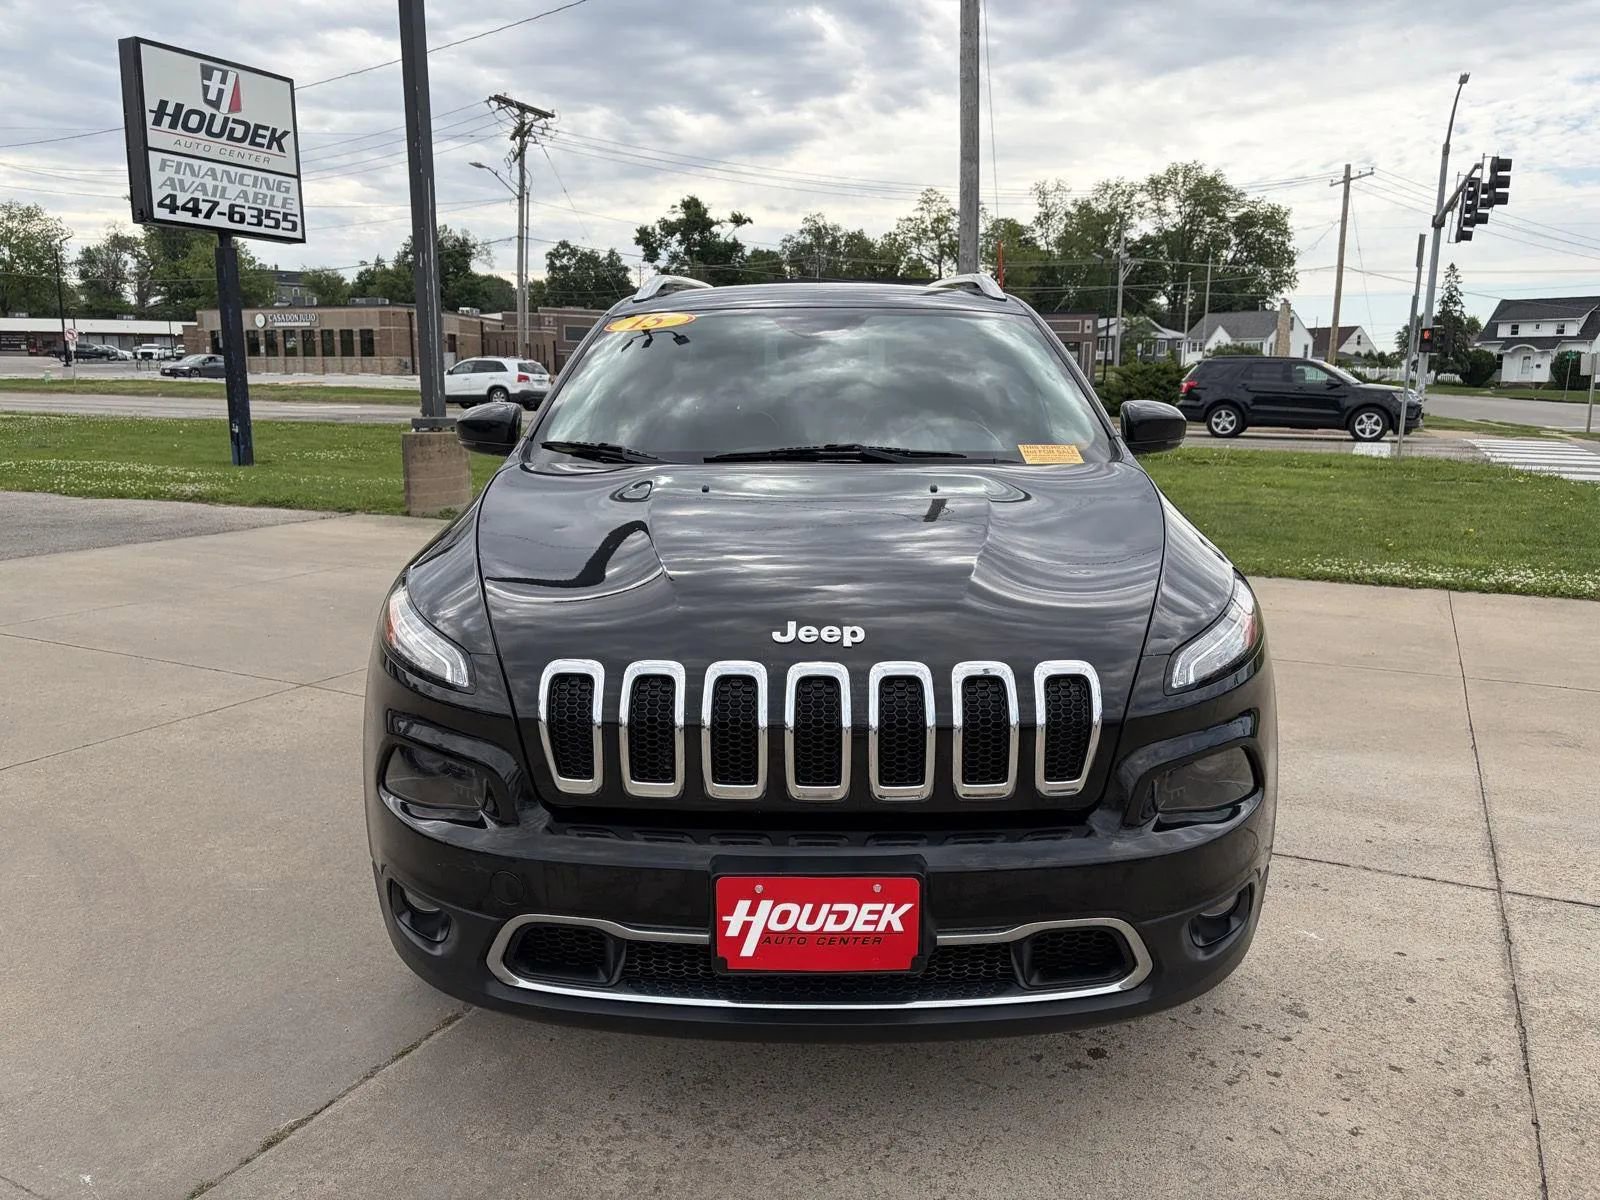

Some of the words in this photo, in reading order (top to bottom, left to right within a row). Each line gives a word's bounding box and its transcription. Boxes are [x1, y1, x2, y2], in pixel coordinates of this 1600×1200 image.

[149, 98, 291, 153] HOUDEK
[173, 139, 211, 153] AUTO
[219, 147, 271, 165] CENTER
[158, 158, 292, 194] FINANCING
[158, 176, 295, 210] AVAILABLE
[157, 193, 298, 232] 447-6355
[771, 620, 866, 647] Jeep
[722, 899, 915, 957] HOUDEK
[761, 936, 807, 946] AUTO
[816, 936, 883, 946] CENTER
